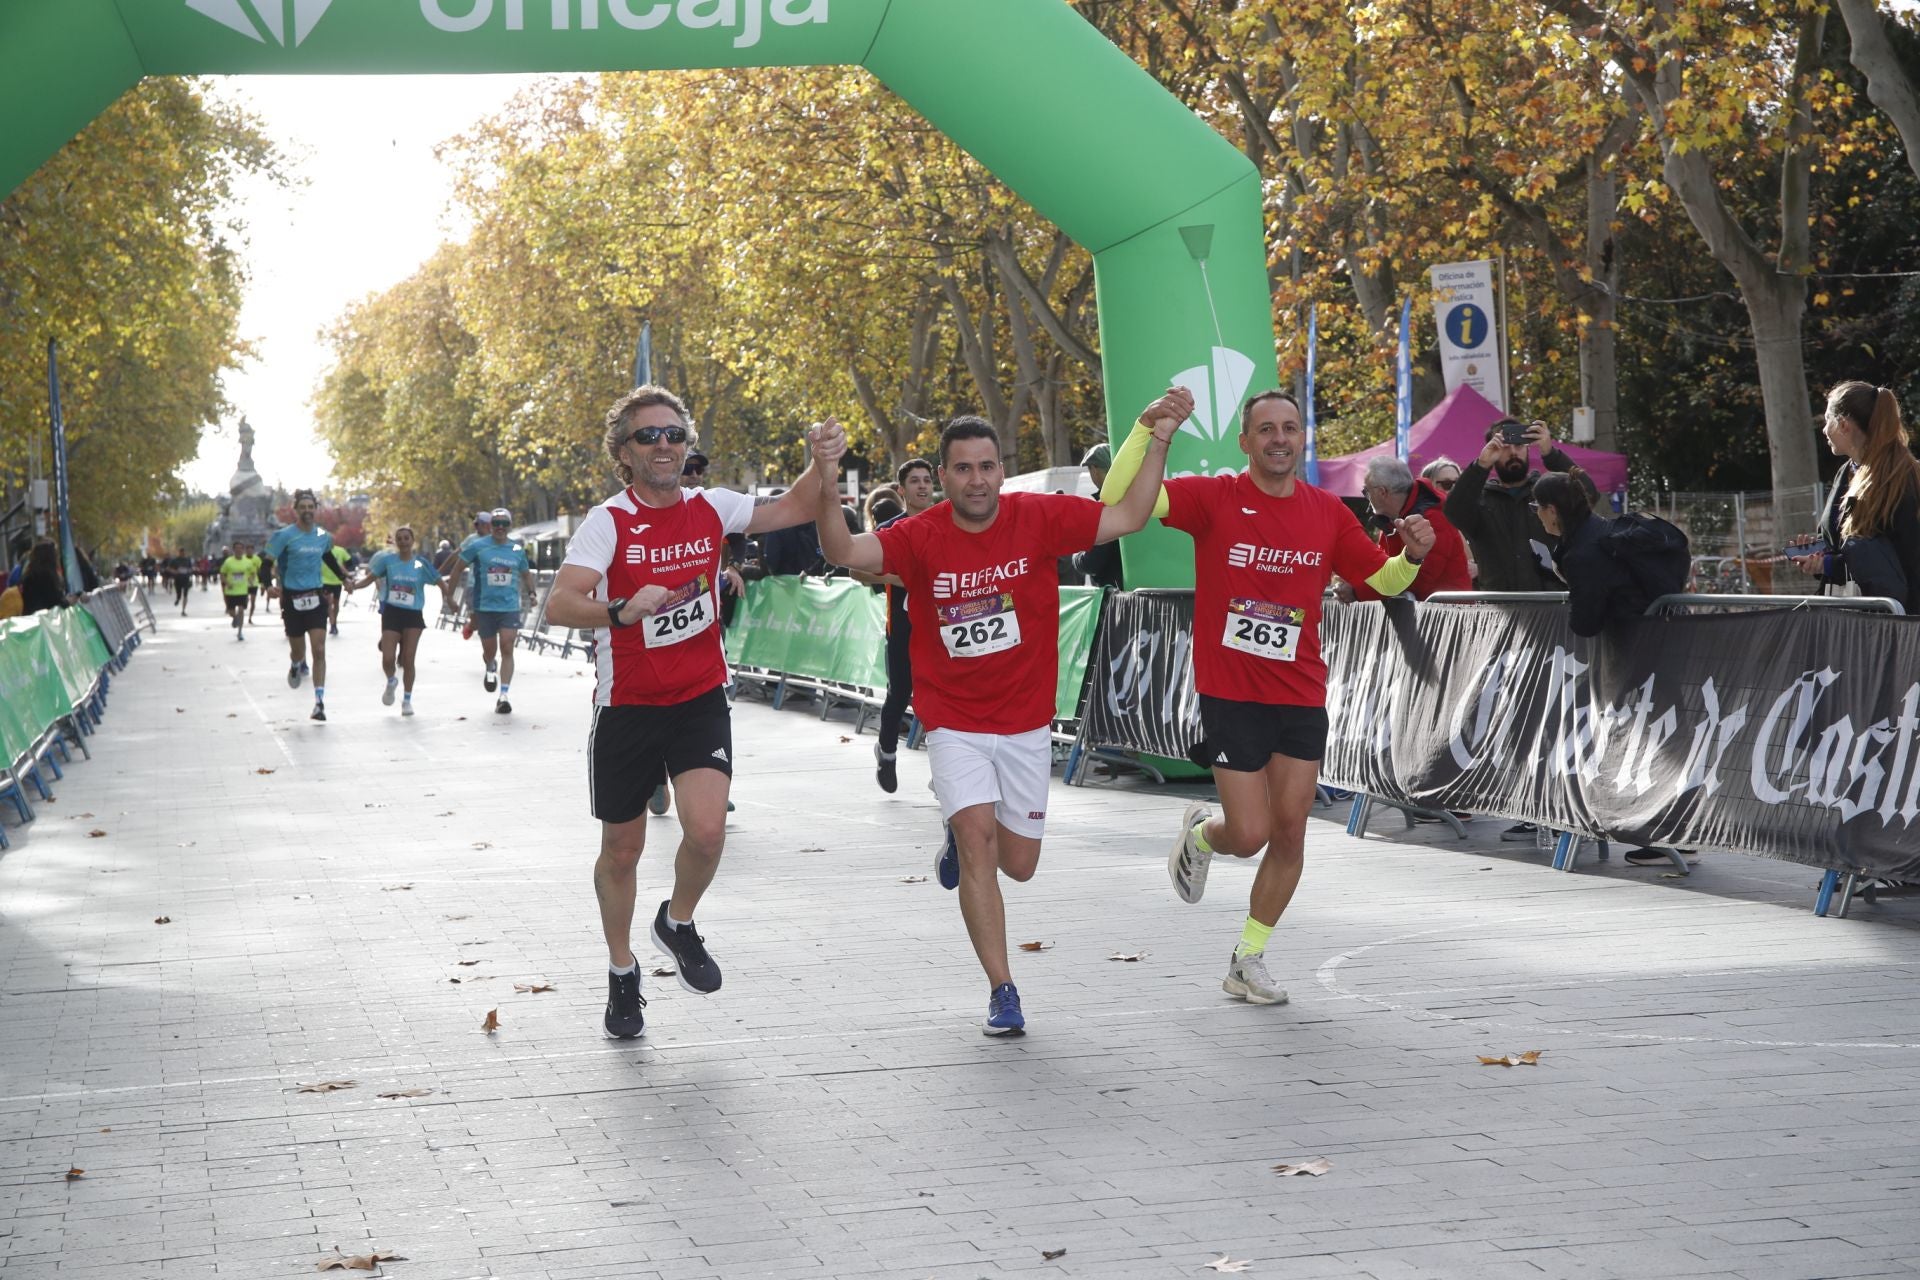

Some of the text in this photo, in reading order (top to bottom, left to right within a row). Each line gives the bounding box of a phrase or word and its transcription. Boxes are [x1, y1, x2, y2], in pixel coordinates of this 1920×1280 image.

[1439, 270, 1475, 281] Oficina de
[650, 537, 713, 563] EIFFAGE
[1257, 547, 1323, 567] EIFFAGE
[494, 574, 506, 582] 33
[652, 563, 680, 574] ENERGÍA
[960, 557, 1028, 588] EIFFAGE
[1256, 562, 1294, 574] ENERGÍA
[395, 592, 407, 601] 32
[961, 584, 999, 598] ENERGÍA
[654, 600, 705, 637] 264
[951, 617, 1008, 648] 262
[1235, 619, 1288, 649] 263
[1676, 676, 1748, 799] de
